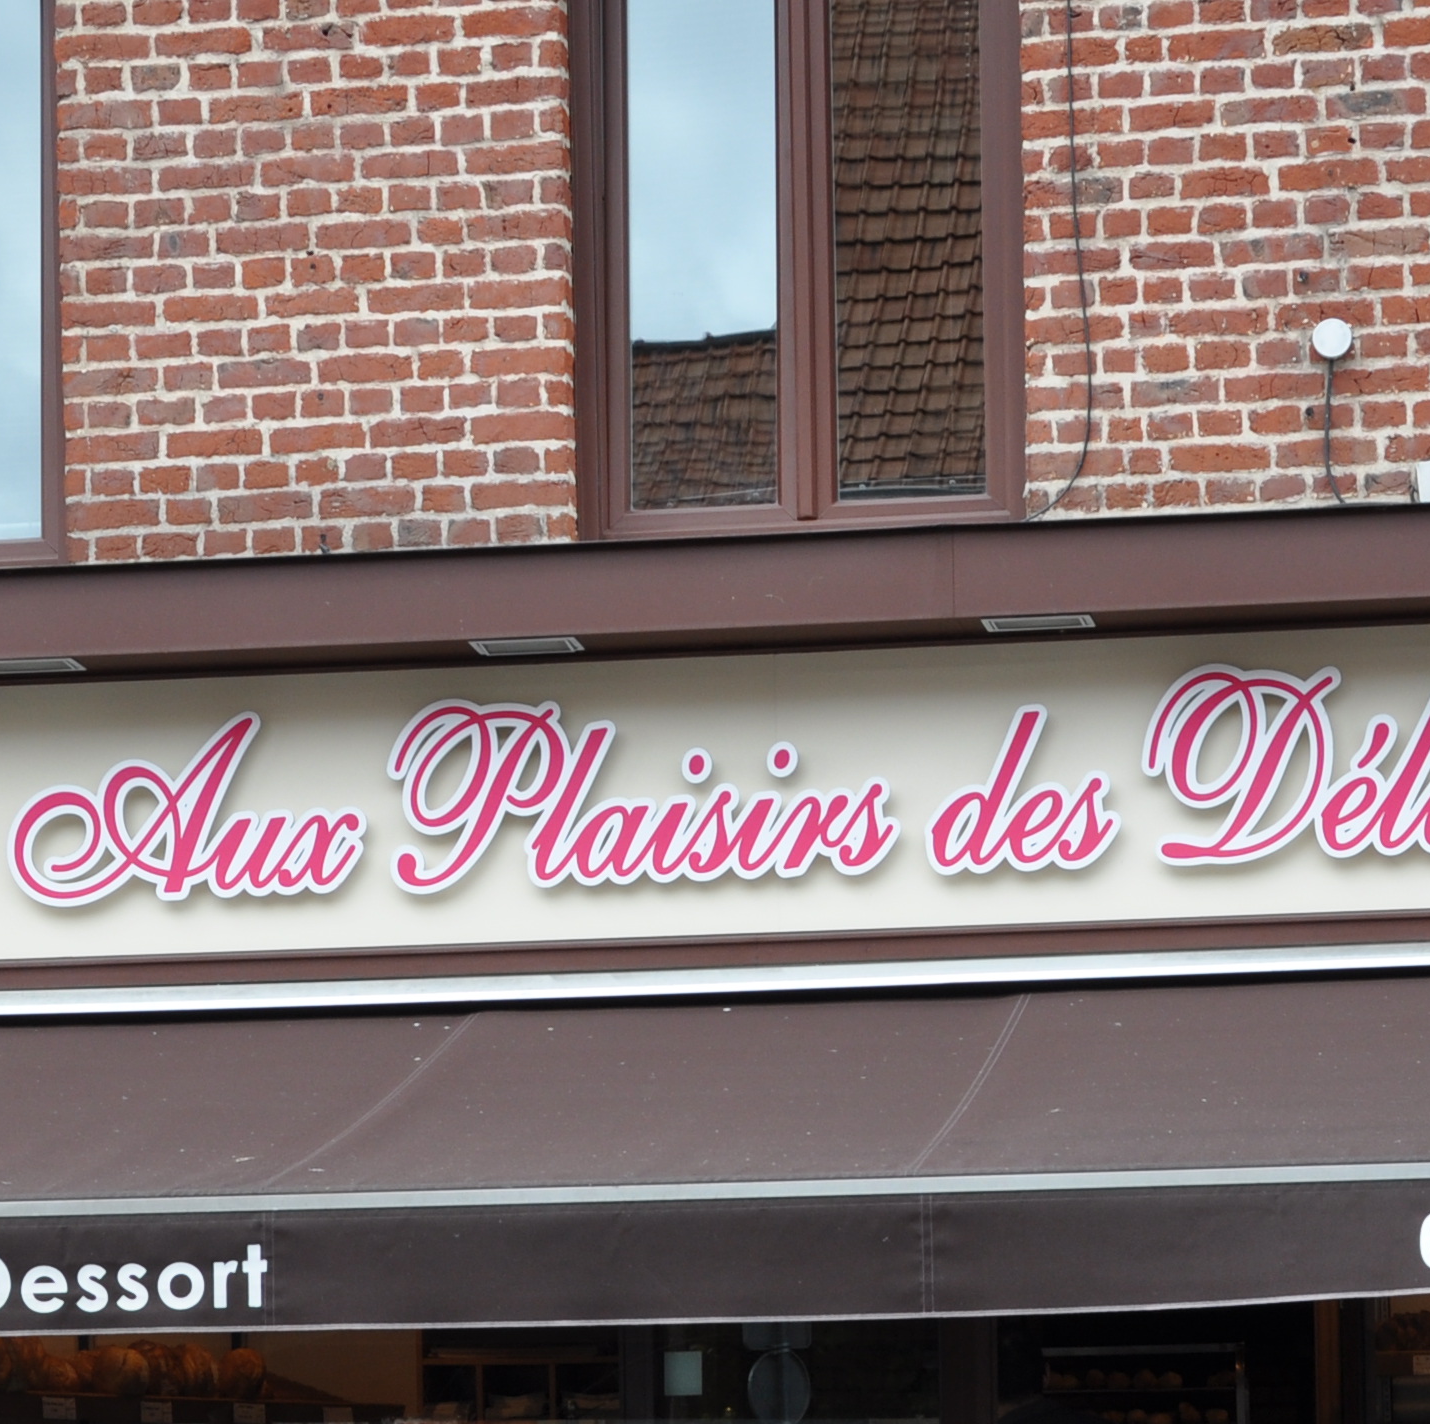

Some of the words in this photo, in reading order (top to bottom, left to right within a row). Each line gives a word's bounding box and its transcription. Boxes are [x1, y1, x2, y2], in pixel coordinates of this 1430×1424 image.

[10, 717, 363, 904] Aux
[391, 703, 899, 891] Plaisirs
[927, 706, 1118, 872] des
